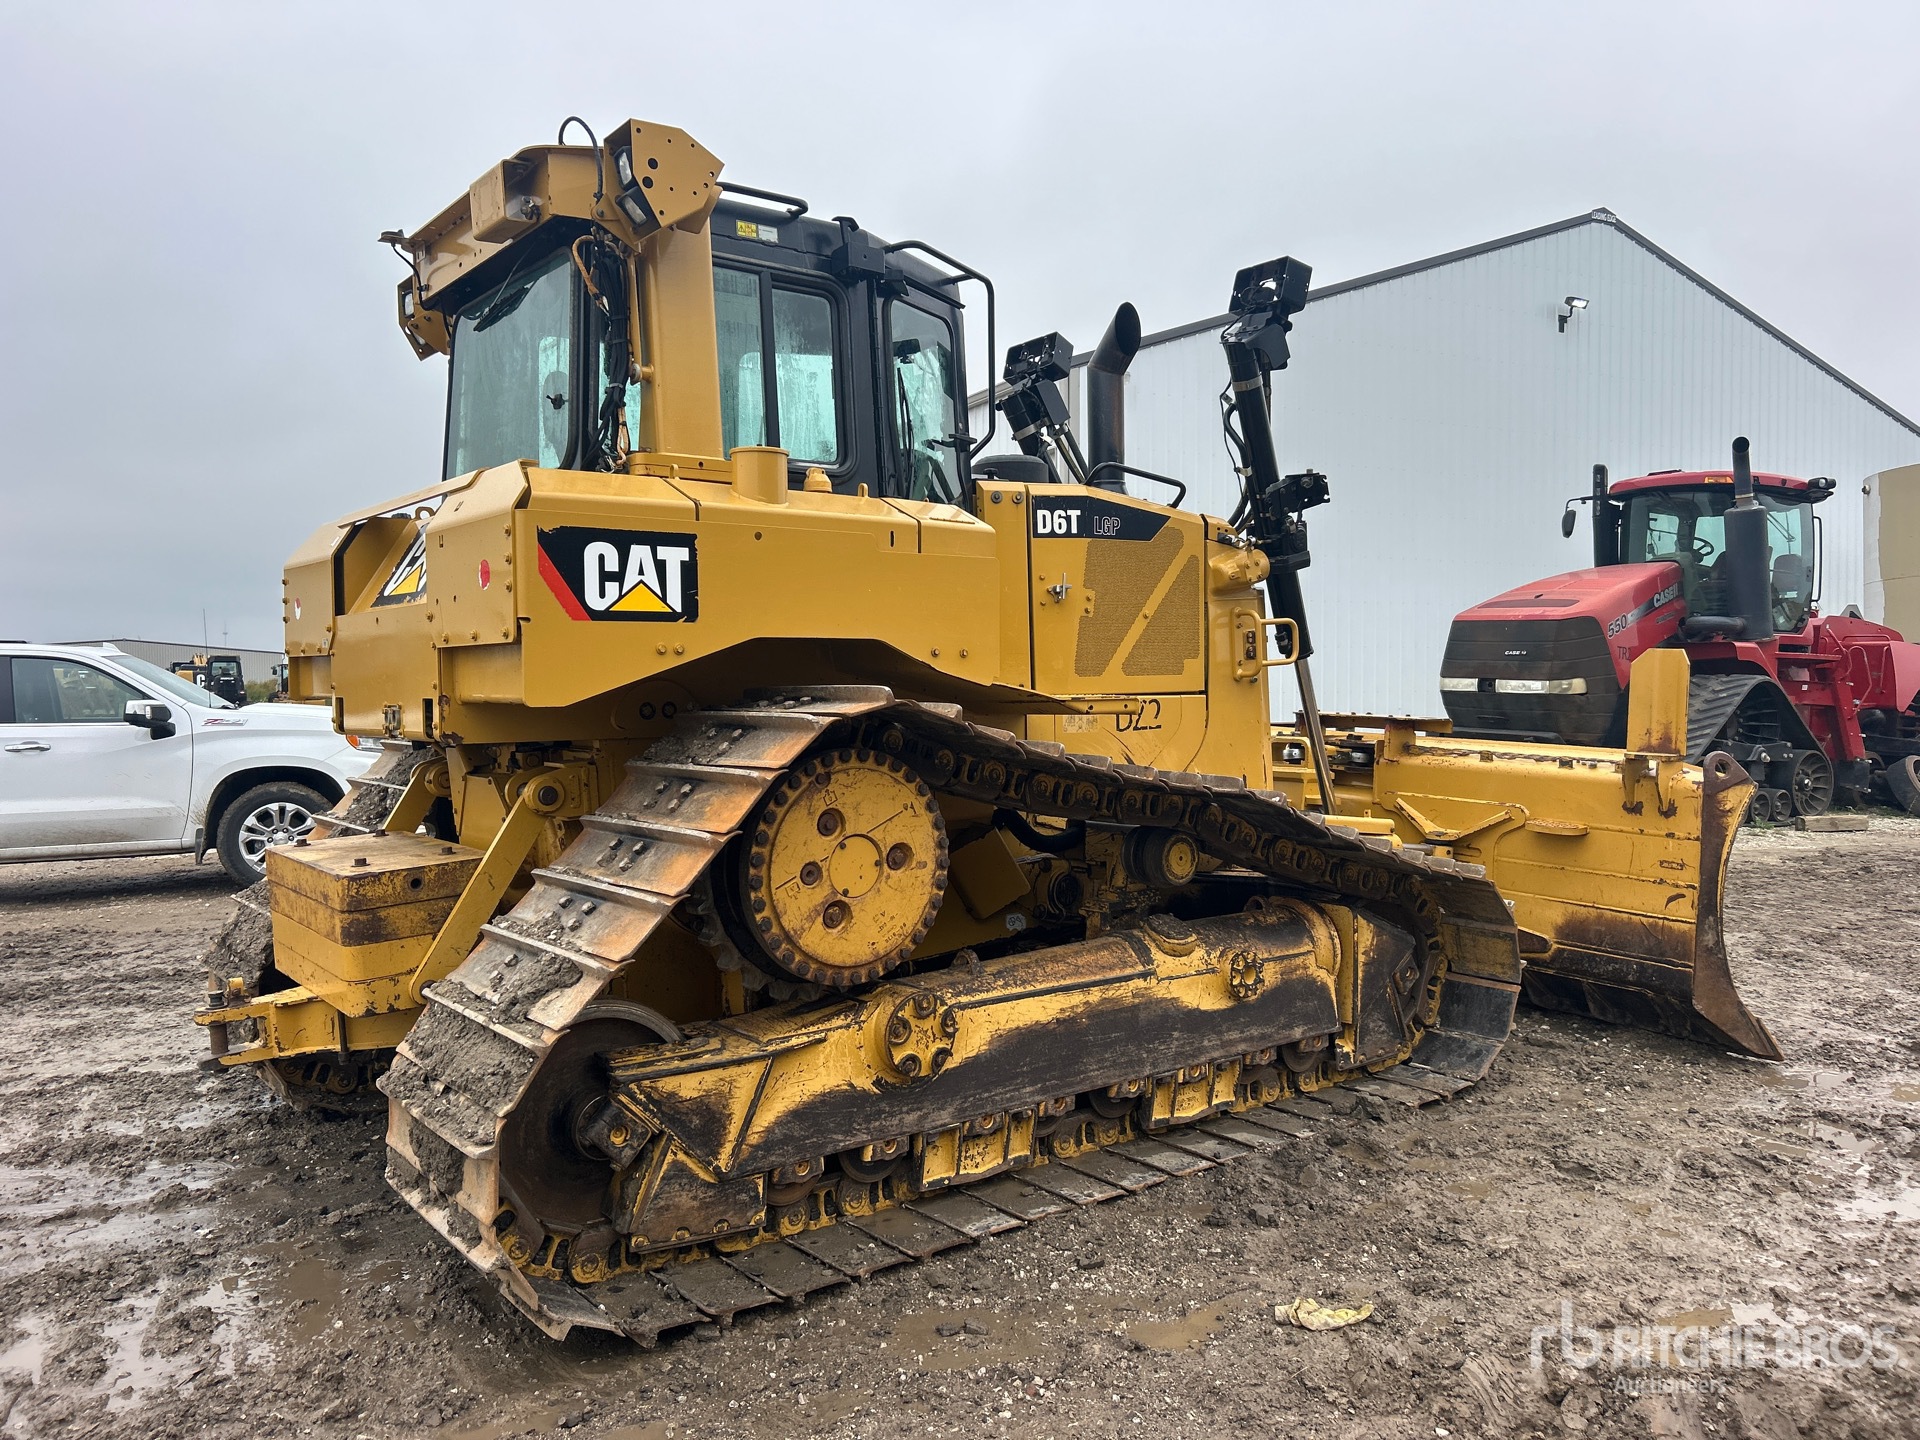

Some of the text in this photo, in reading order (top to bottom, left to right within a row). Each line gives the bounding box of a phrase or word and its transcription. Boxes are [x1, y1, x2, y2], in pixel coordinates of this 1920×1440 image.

[1036, 509, 1120, 536] D6T LGP
[383, 533, 427, 597] CA
[583, 541, 690, 613] CAT
[1653, 586, 1674, 608] CASE
[1607, 613, 1628, 639] 550
